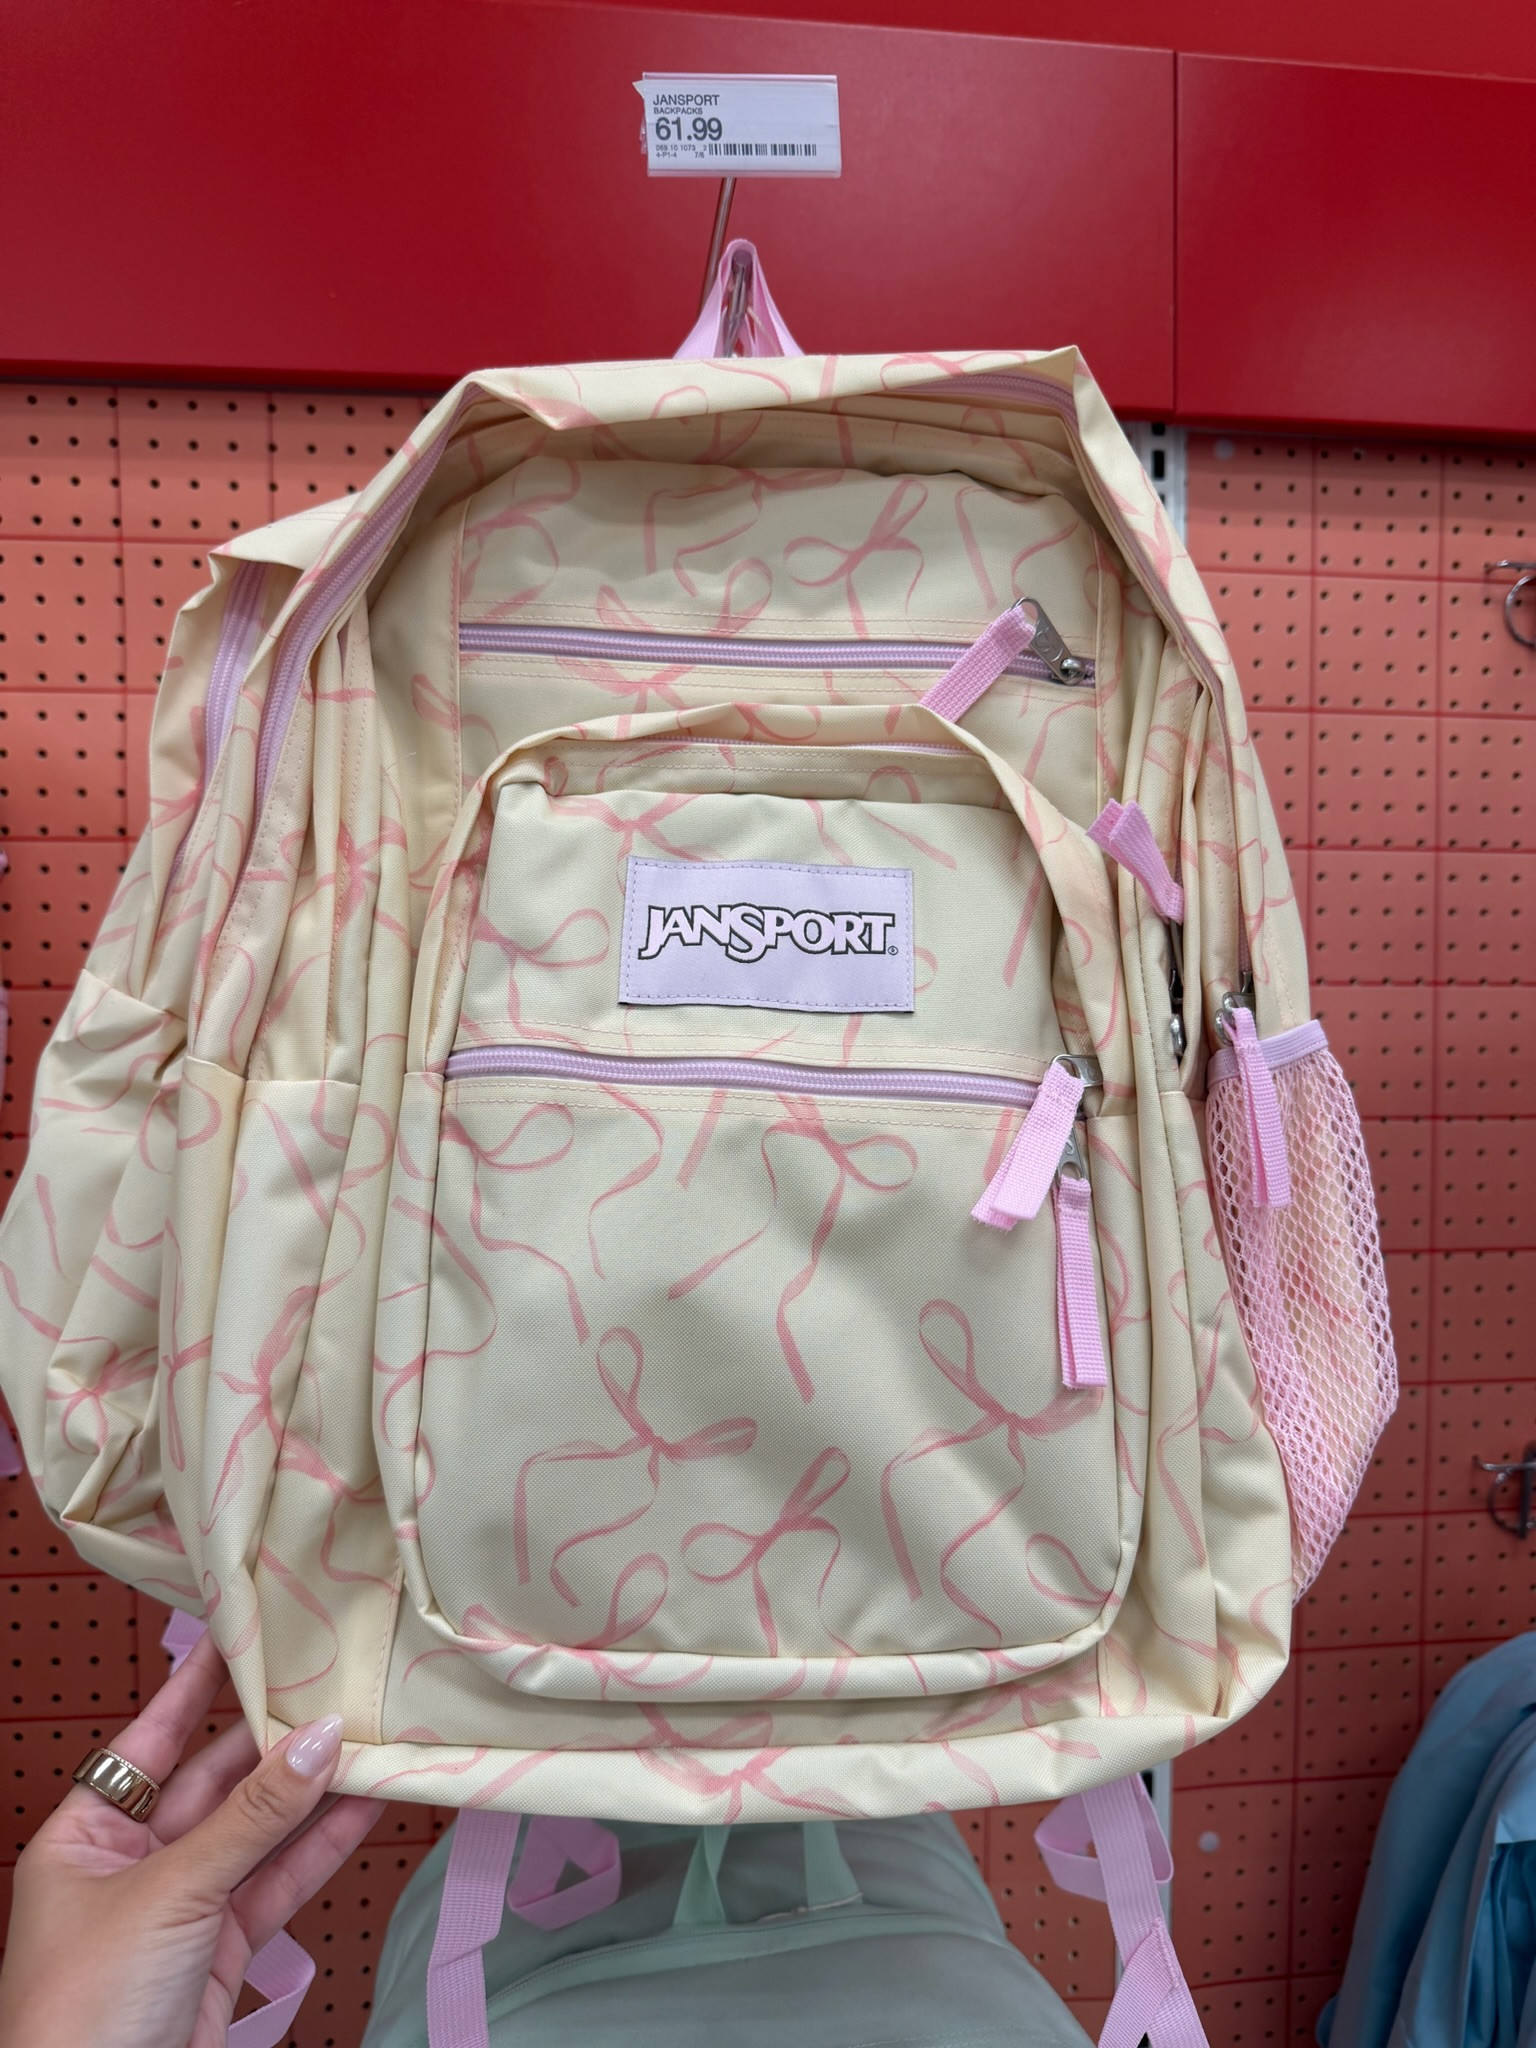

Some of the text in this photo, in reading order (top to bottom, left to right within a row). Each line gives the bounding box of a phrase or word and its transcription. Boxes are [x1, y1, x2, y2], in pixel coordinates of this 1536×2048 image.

[653, 94, 719, 106] JANSPORT
[653, 107, 703, 115] BACKPACKS
[655, 117, 722, 141] 61.99
[670, 144, 679, 152] 10
